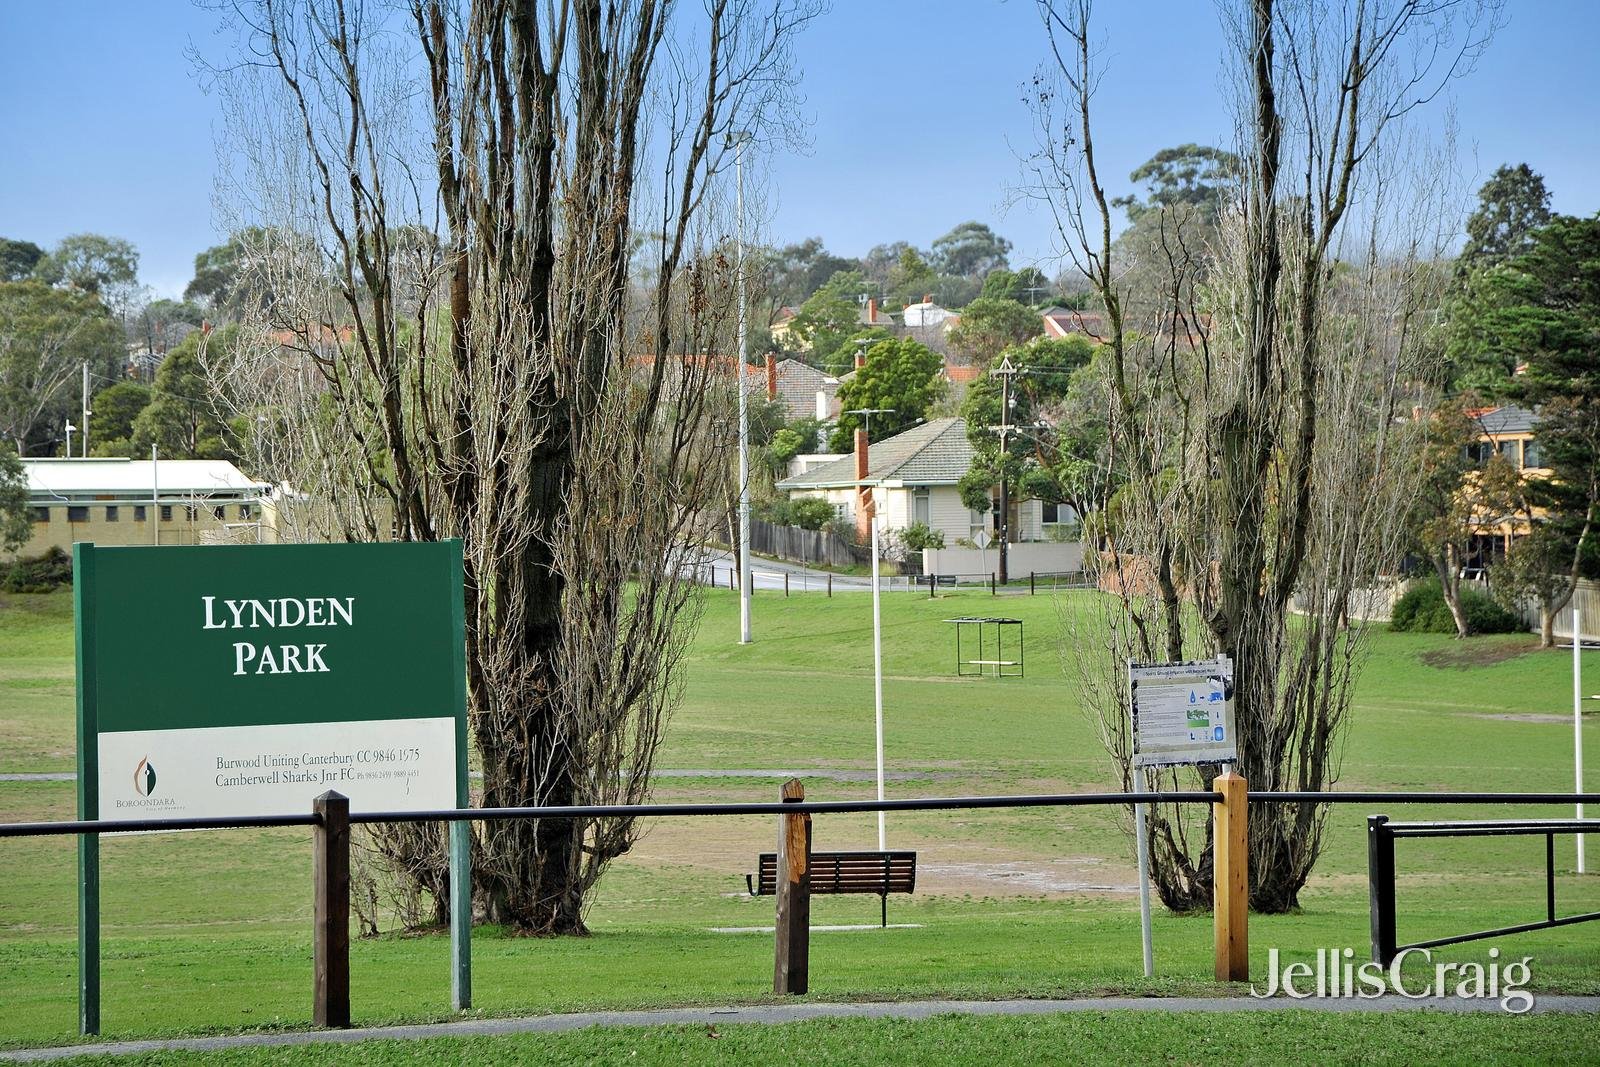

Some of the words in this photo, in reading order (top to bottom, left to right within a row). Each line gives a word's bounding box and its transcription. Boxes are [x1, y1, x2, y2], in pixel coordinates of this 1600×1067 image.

[201, 596, 355, 629] LYNDEN
[232, 642, 331, 676] PARK
[216, 755, 260, 769] Burwood
[264, 753, 299, 769] Uniting
[302, 751, 353, 767] Canterbury
[357, 750, 371, 763] CC
[373, 748, 396, 763] 9846
[215, 771, 279, 787] Camberwell
[282, 769, 318, 784] Sharks
[320, 769, 338, 785] Jnr
[341, 767, 355, 780] FC
[116, 798, 175, 807] BOROONDARA
